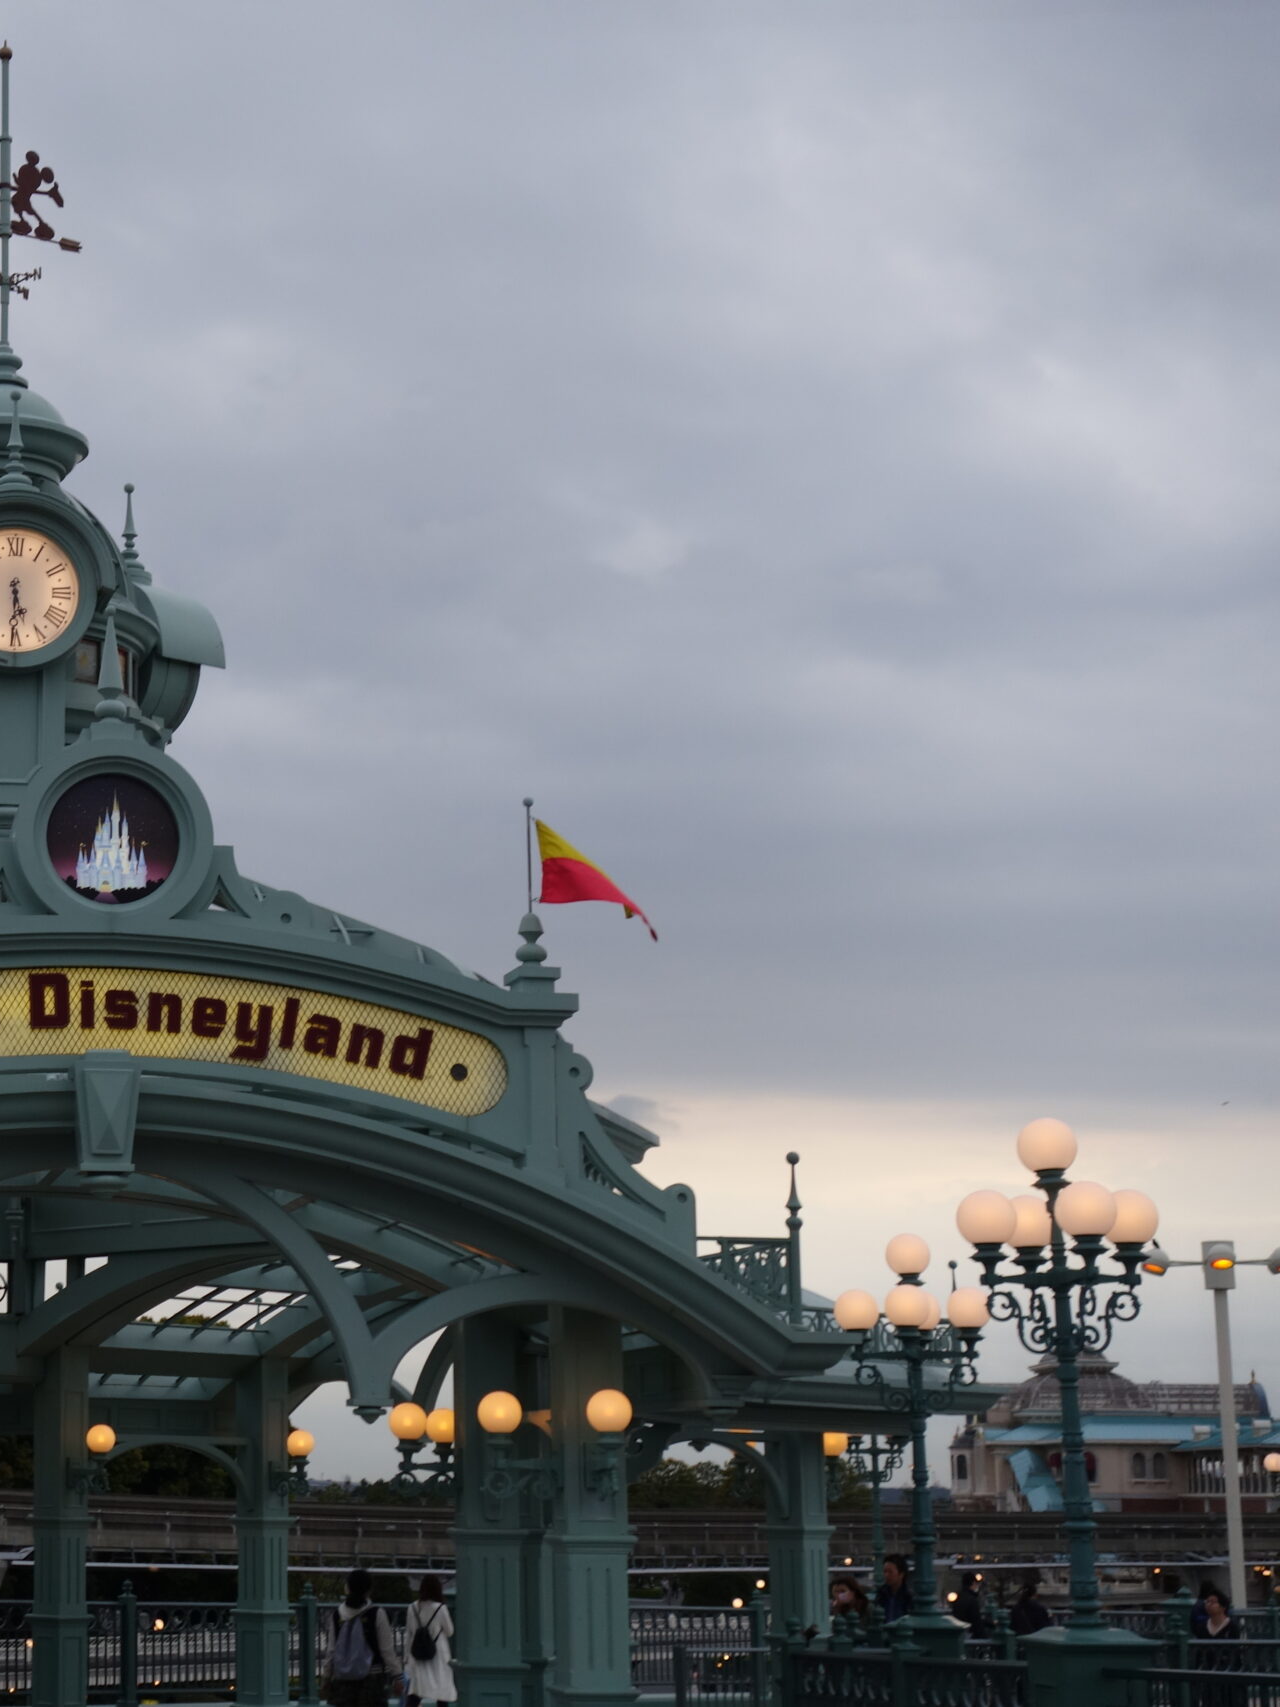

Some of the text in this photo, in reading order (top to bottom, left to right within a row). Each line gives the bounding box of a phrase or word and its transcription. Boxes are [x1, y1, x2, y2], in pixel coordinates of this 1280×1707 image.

[7, 537, 24, 557] XII
[32, 545, 44, 562] I
[46, 563, 65, 577] II
[52, 586, 71, 600] III
[43, 604, 67, 629] IIII
[33, 624, 46, 642] V
[28, 972, 434, 1081] Disneyland
